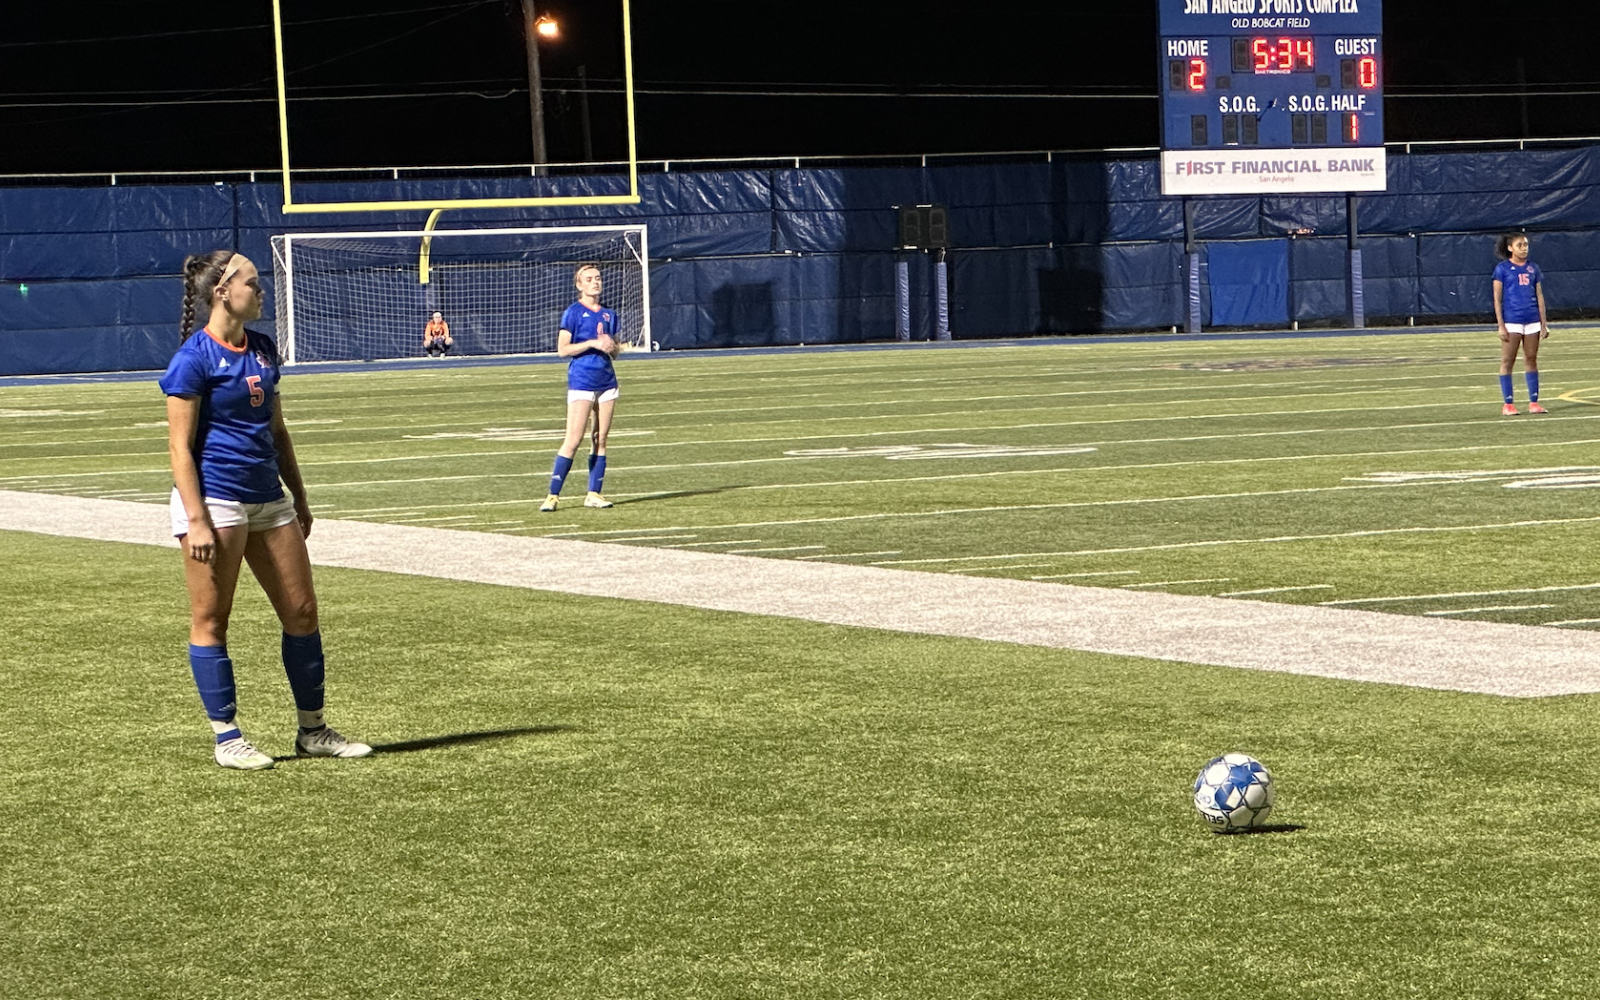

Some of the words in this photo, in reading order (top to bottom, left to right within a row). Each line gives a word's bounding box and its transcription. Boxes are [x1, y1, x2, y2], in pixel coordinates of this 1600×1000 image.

[1184, 0, 1208, 14] SAN
[1212, 0, 1255, 14] ANGELO
[1259, 0, 1303, 14] SPORTS
[1306, 0, 1358, 14] COMPLEX
[1231, 18, 1249, 28] OLD
[1251, 18, 1285, 28] BOBCAT
[1287, 18, 1310, 28] FIELD
[1167, 40, 1208, 56] HOME
[1253, 39, 1313, 69] 5:34
[1335, 38, 1377, 55] GUEST
[1189, 60, 1205, 90] 2
[1359, 58, 1375, 88] 0
[1219, 96, 1260, 113] S.O.G.
[1288, 95, 1329, 112] S.O.G.
[1331, 95, 1366, 111] HALF
[1351, 113, 1358, 141] 1
[1175, 161, 1226, 176] FIRST
[1231, 160, 1322, 174] FINANCIAL
[1327, 158, 1374, 172] BANK
[1272, 175, 1295, 184] Angelo
[1518, 273, 1530, 285] 15
[245, 375, 265, 407] 5
